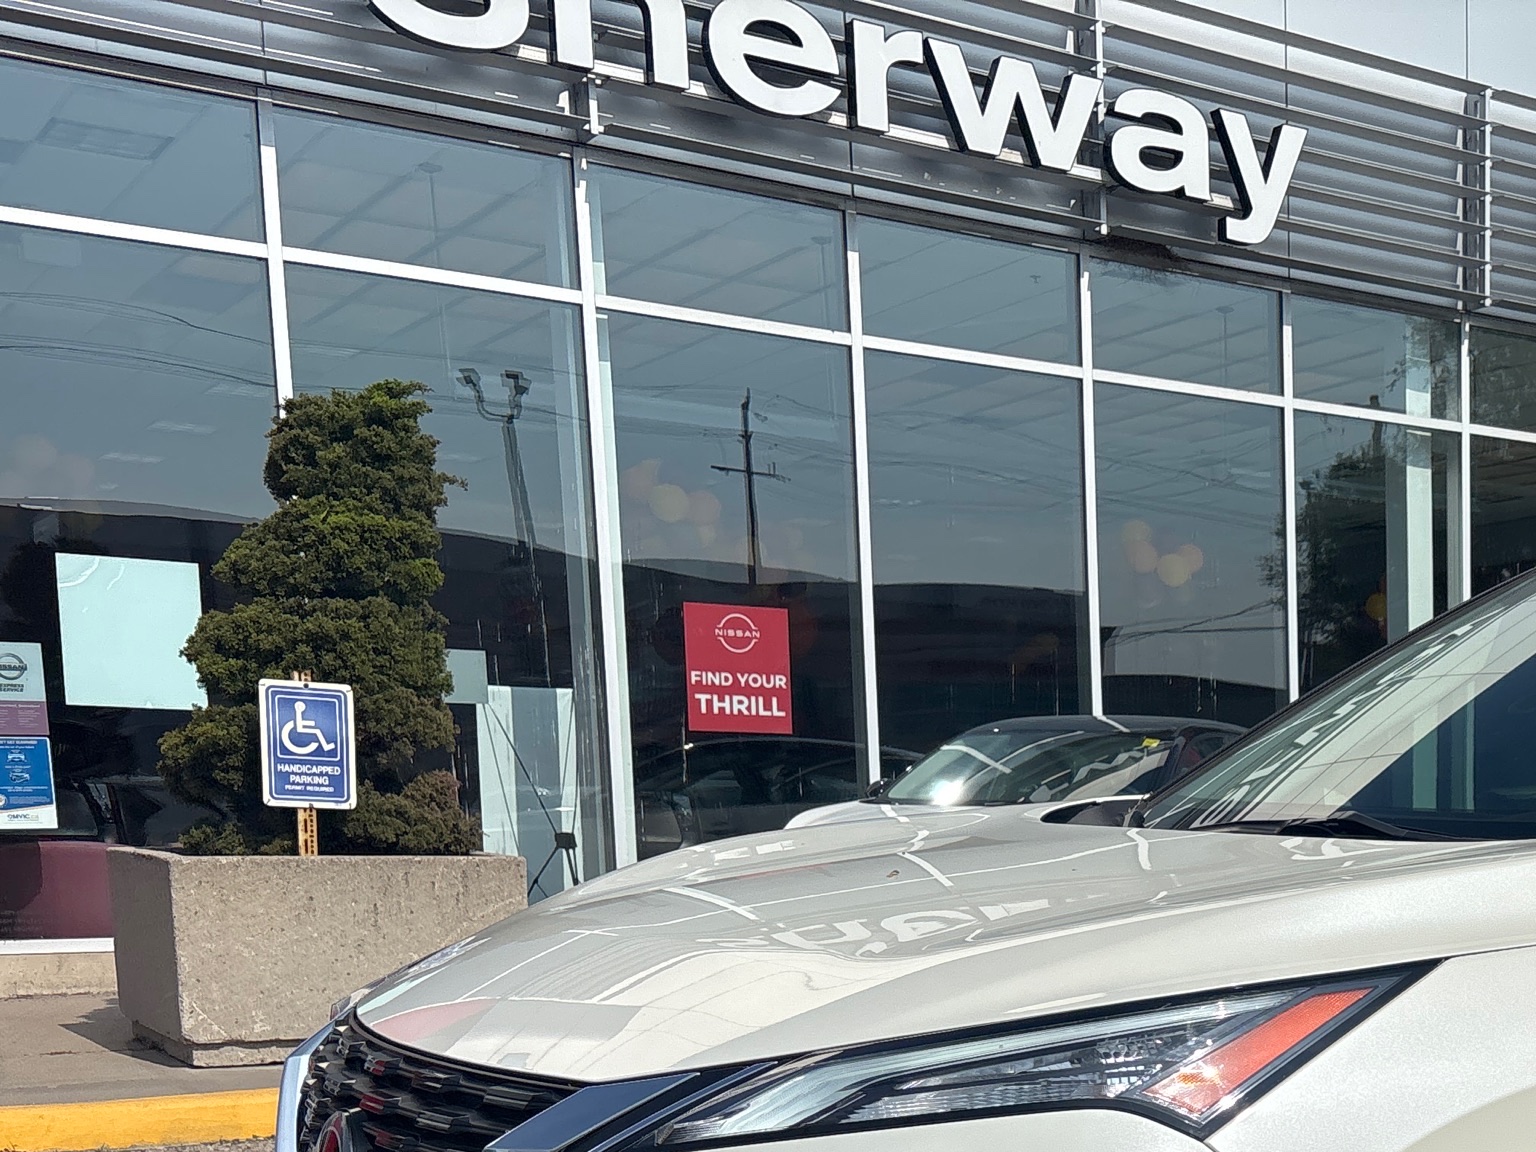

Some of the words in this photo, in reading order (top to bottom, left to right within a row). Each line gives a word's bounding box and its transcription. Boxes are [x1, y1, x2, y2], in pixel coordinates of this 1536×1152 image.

[715, 629, 760, 638] NISSAN
[690, 671, 733, 686] FIND
[737, 672, 787, 689] YOUR
[694, 693, 786, 717] THRILL
[277, 763, 341, 775] HANDICAPPED
[289, 774, 329, 785] PARKING
